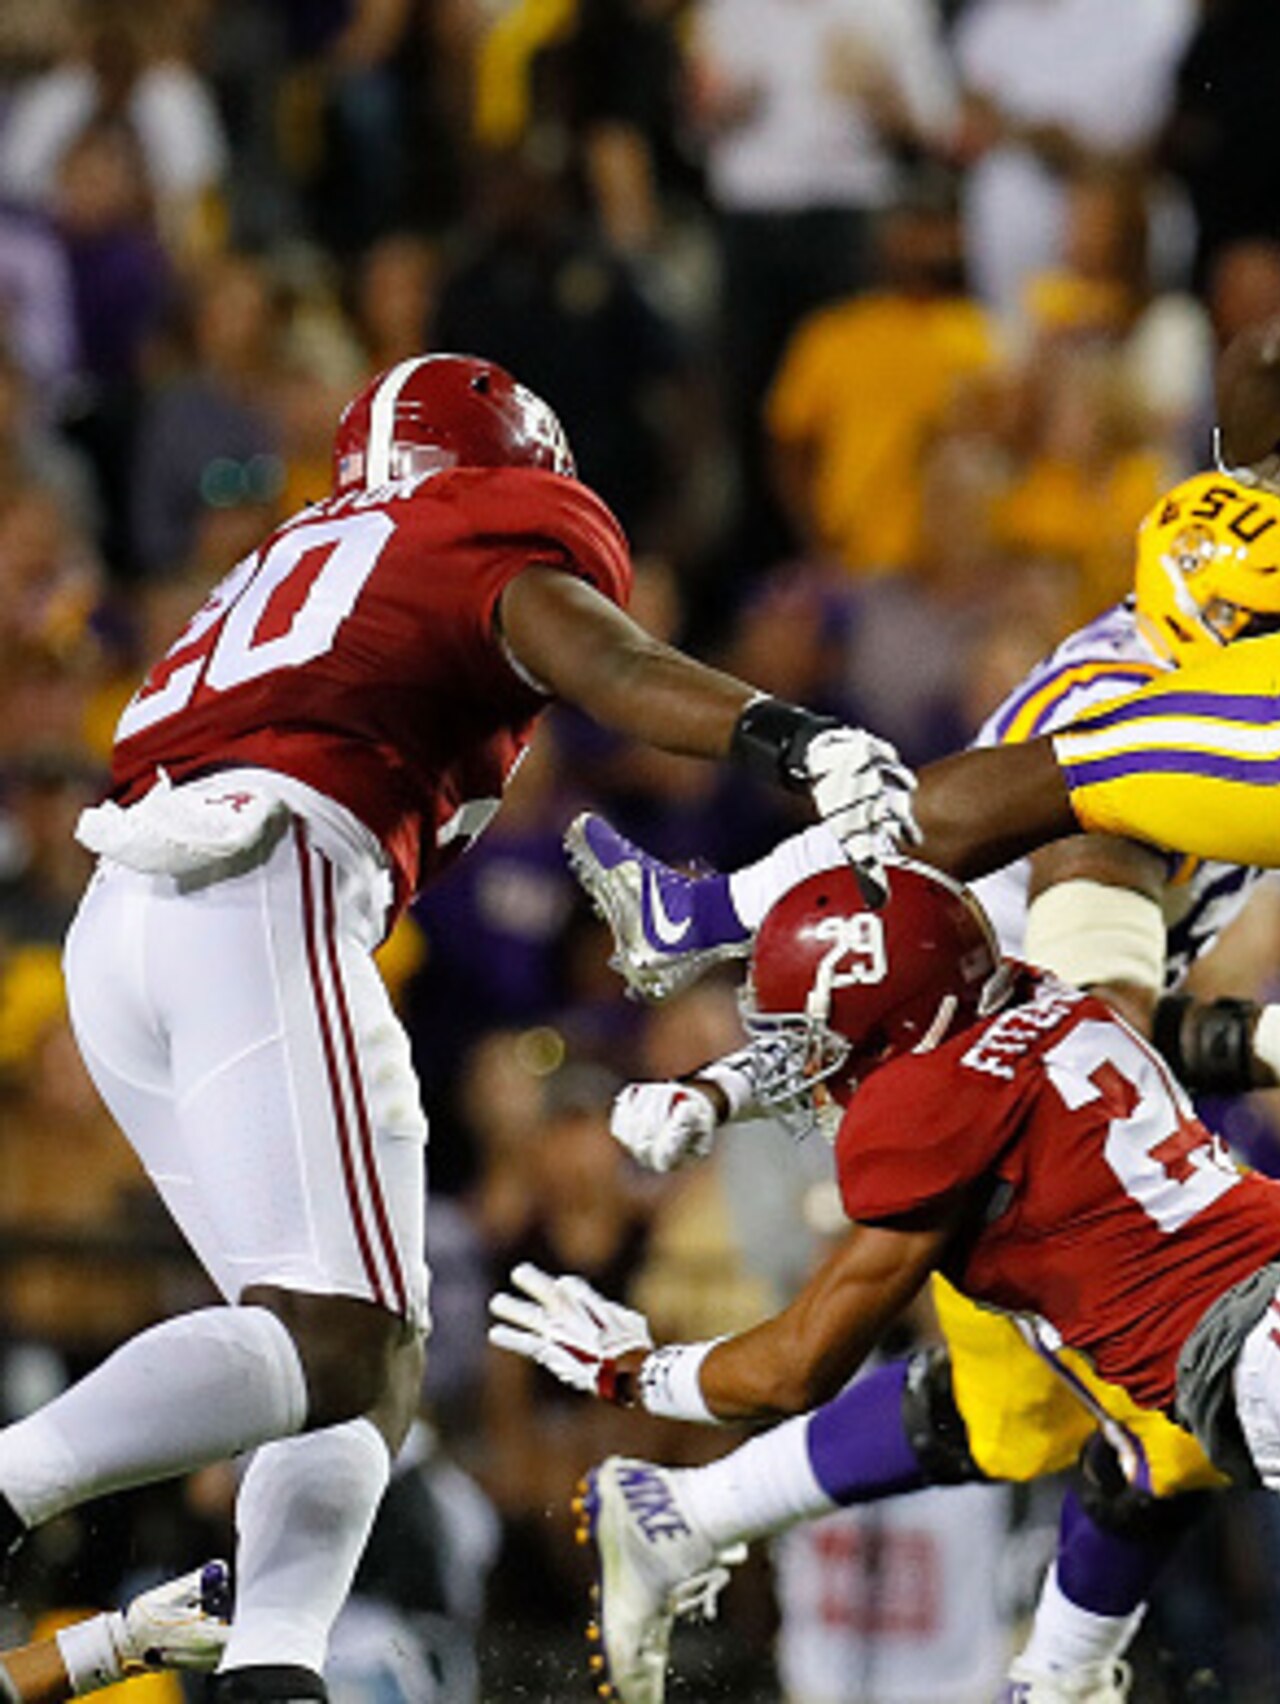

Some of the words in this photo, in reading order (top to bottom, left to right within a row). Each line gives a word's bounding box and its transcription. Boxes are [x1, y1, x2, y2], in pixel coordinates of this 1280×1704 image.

[113, 509, 397, 744] 20
[815, 911, 889, 990] 29
[616, 1467, 693, 1543] NIKE
